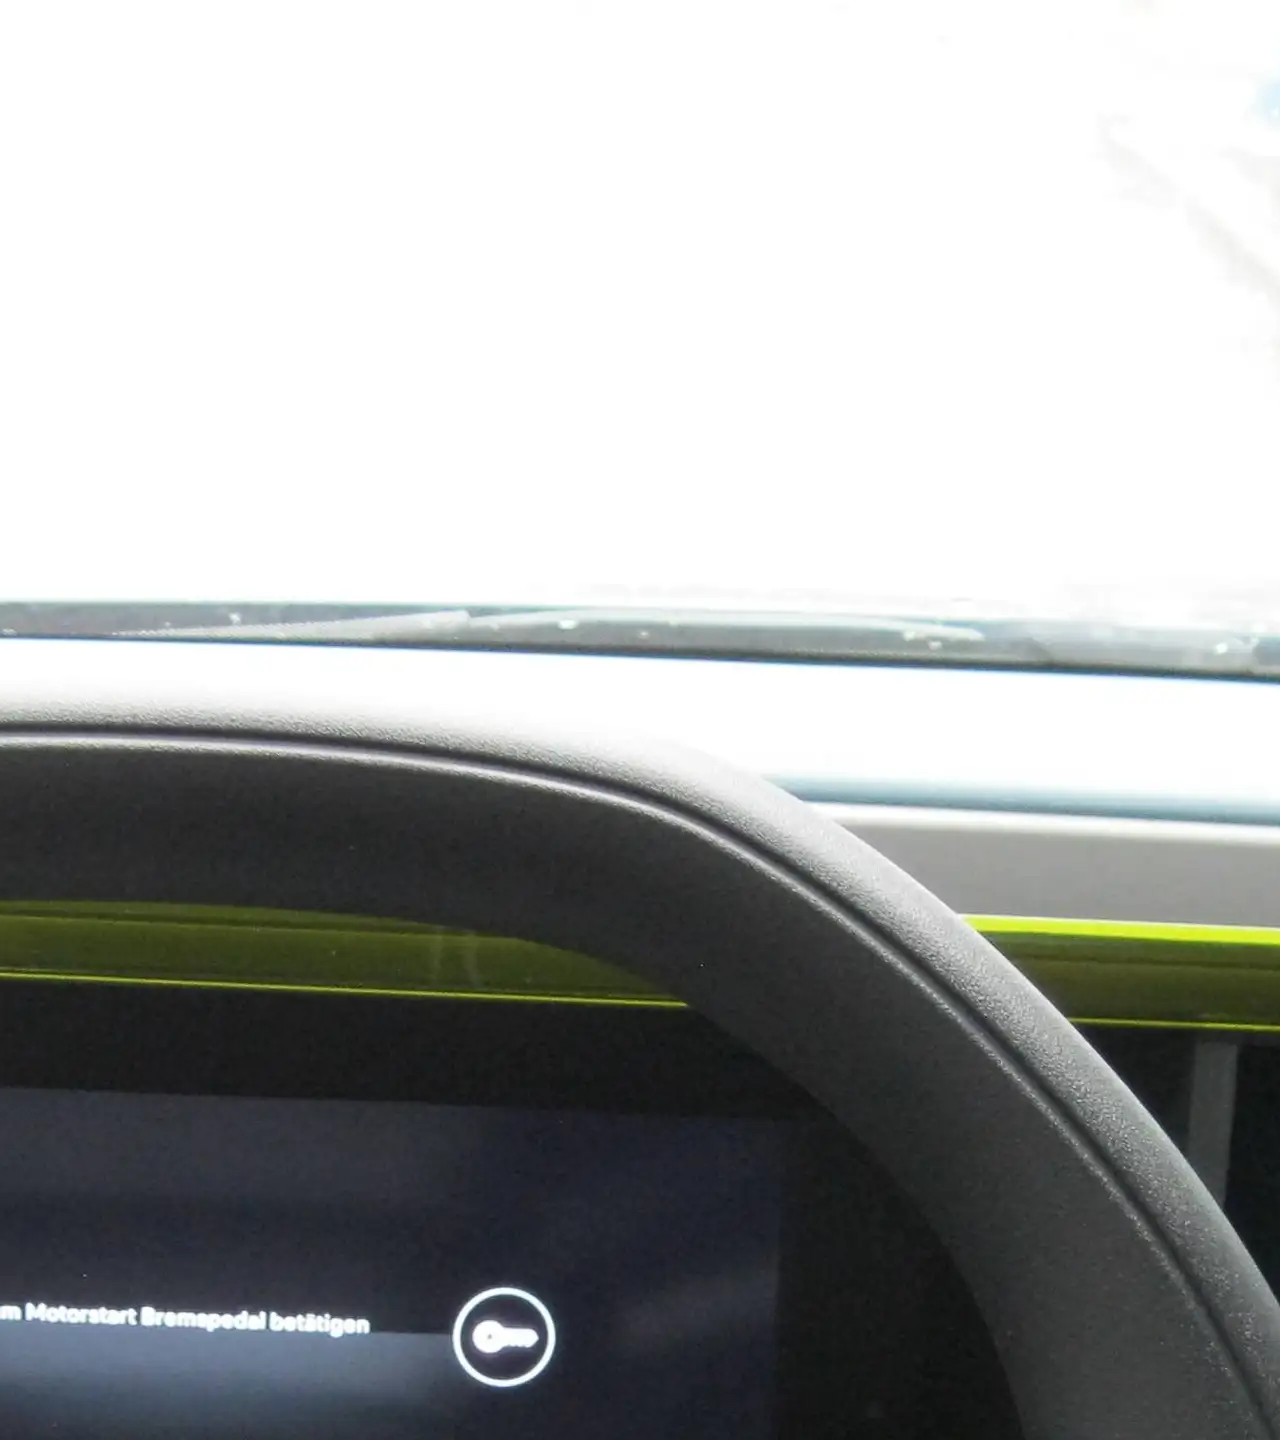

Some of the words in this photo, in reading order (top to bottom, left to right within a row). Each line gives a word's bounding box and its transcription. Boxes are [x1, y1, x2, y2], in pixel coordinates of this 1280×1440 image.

[24, 1302, 137, 1326] Motorstart
[140, 1306, 266, 1332] Bremspedal
[269, 1311, 370, 1338] betätigen
